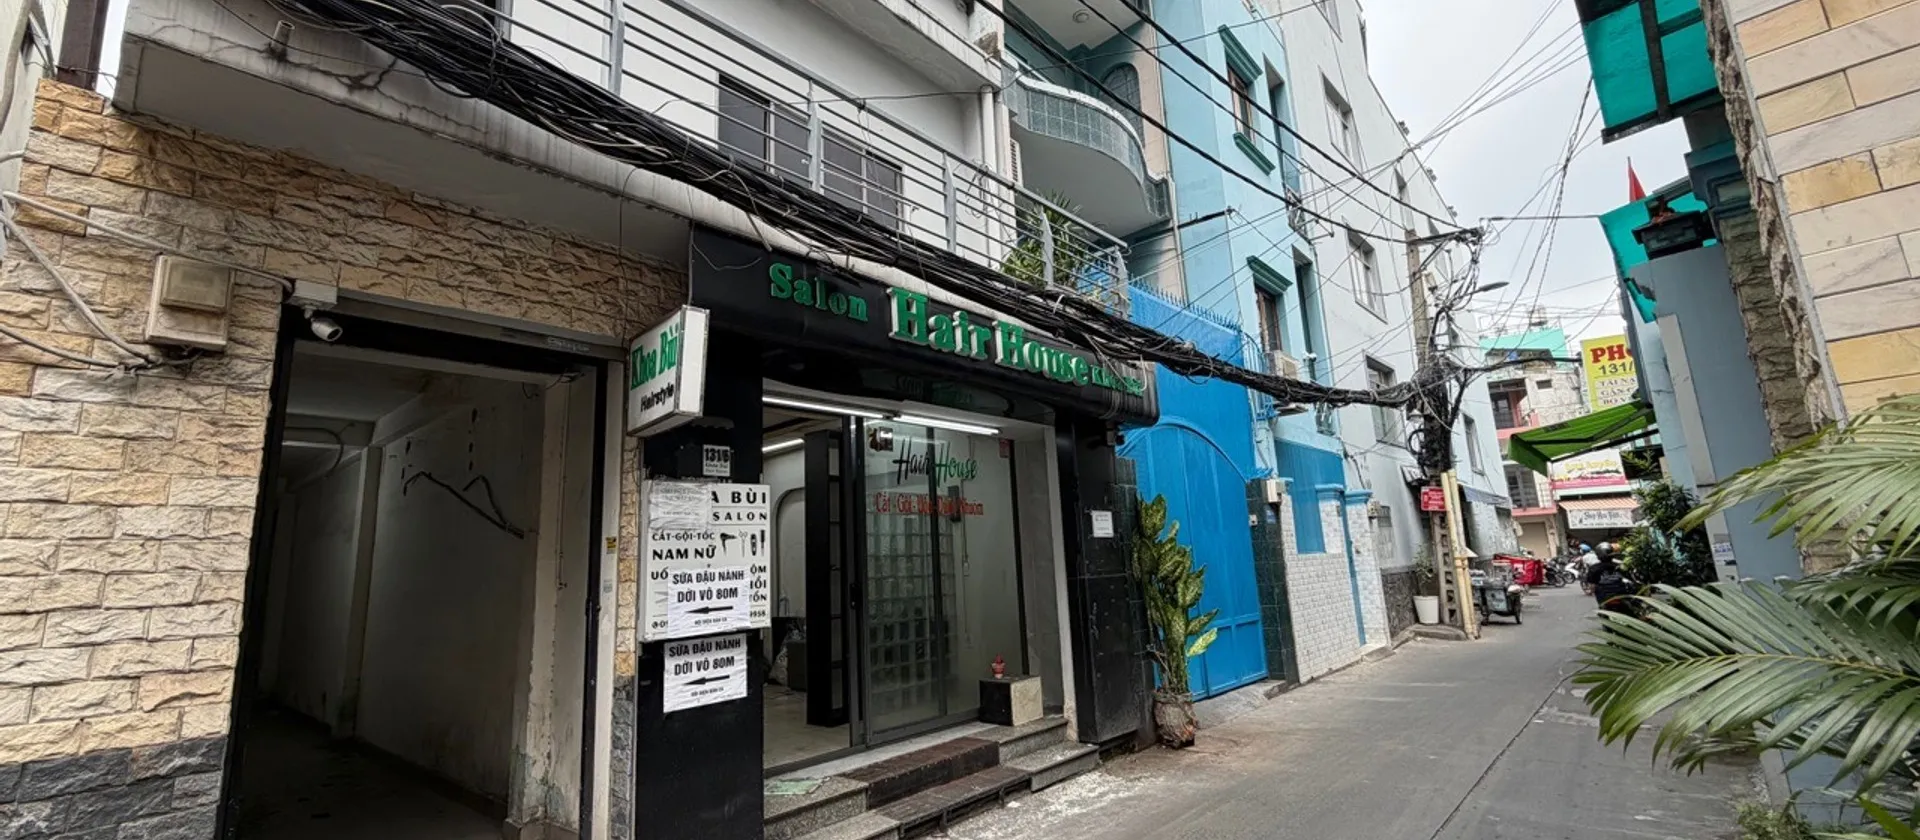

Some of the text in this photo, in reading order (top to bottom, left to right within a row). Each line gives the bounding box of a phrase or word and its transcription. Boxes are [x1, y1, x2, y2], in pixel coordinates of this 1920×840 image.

[769, 262, 868, 322] Salon
[886, 286, 991, 361] Hair
[992, 320, 1089, 387] House
[630, 322, 679, 391] Khoa Bùi
[1598, 361, 1634, 375] 131/
[892, 436, 978, 488] Hair House
[731, 487, 766, 504] BÙI
[712, 511, 767, 521] SALON
[652, 544, 717, 561] NAM NỮ
[651, 563, 766, 580] UỐ ỘM
[696, 569, 715, 585] ĐẬU
[718, 569, 745, 582] NÀNH
[677, 586, 738, 603] DỜI VÔ 80M
[692, 641, 713, 656] ĐẬU
[715, 637, 741, 651] NÀNH
[674, 655, 735, 676] DỜI VÔ 80M
